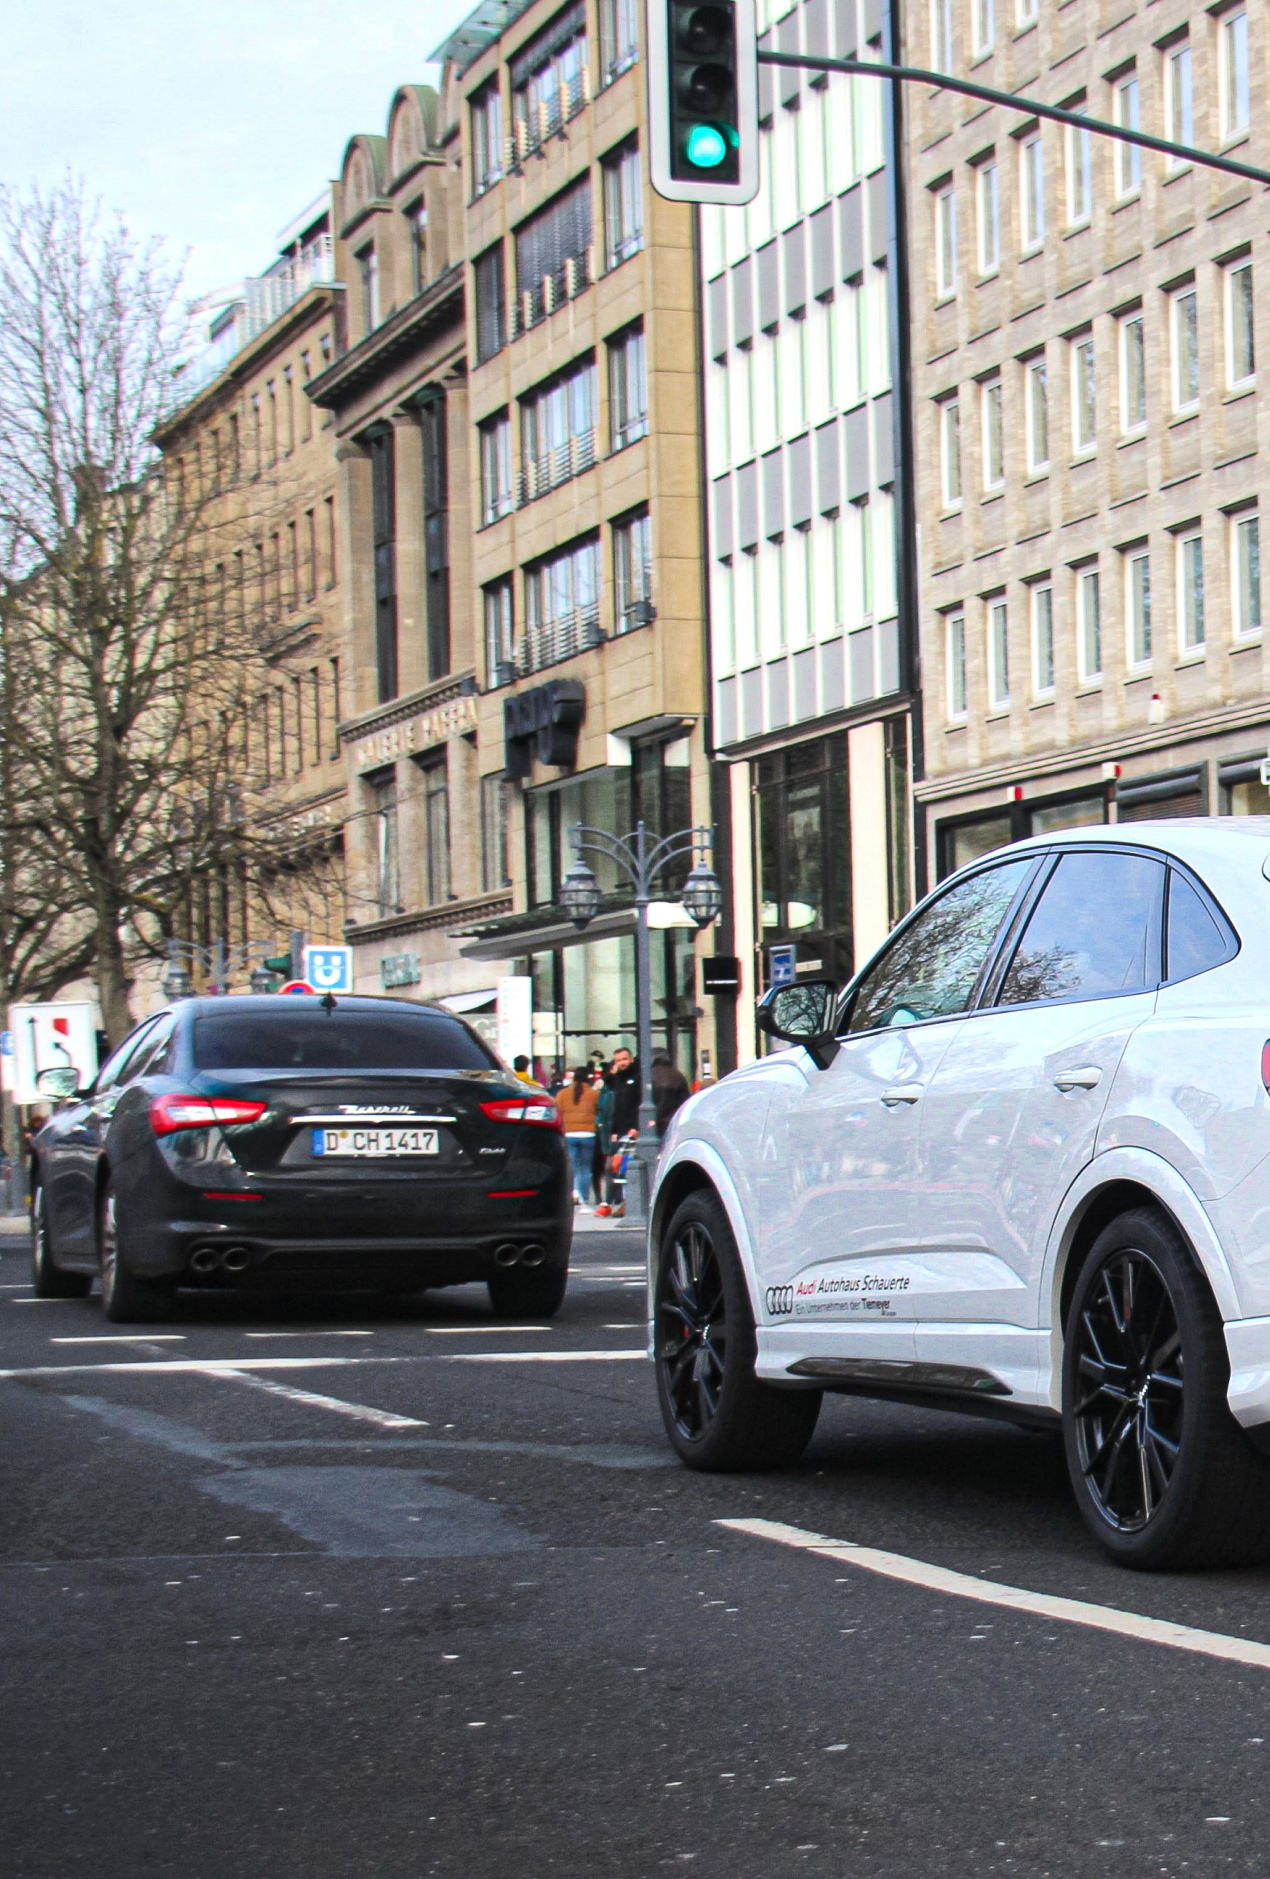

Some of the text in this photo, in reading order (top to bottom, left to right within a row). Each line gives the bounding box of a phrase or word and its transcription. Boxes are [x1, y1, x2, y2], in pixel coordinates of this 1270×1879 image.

[326, 1132, 435, 1151] D CH 1417
[796, 1275, 910, 1295] Audi Autohaus Schauerte
